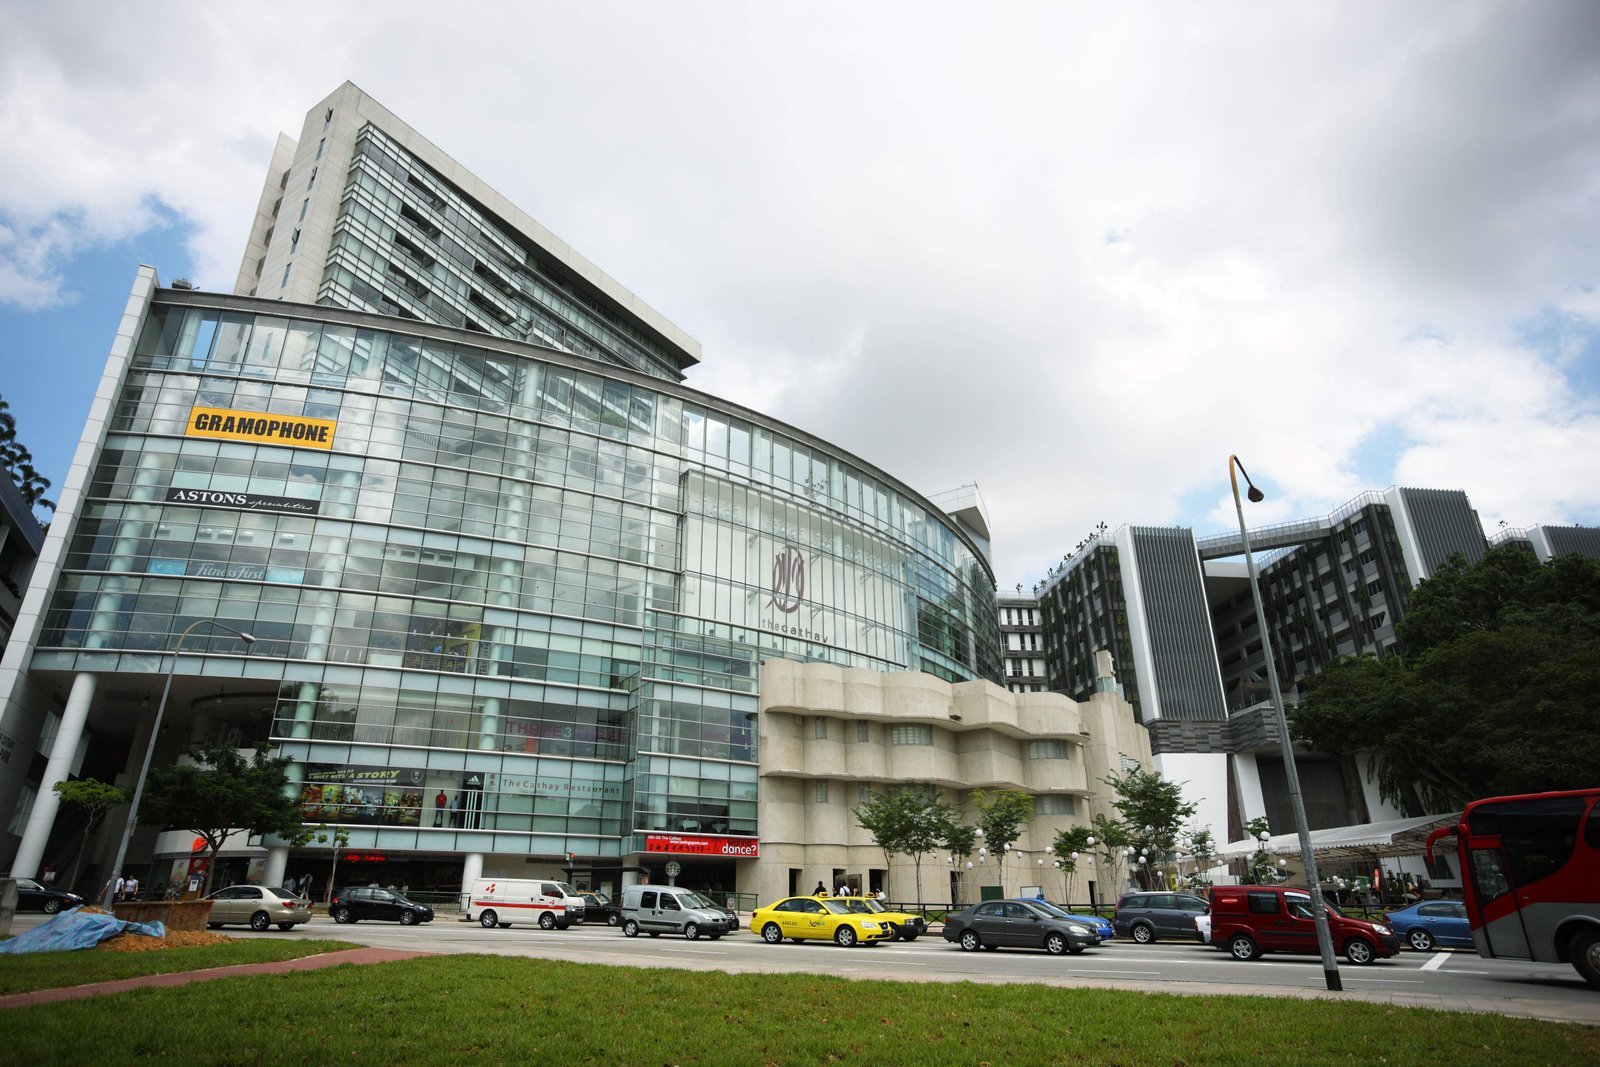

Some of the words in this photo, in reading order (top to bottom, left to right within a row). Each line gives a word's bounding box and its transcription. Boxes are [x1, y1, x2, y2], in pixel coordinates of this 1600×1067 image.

[194, 413, 329, 443] GRAMOPHONE
[173, 490, 247, 505] ASTONS
[356, 769, 400, 779] STORY
[503, 778, 521, 788] The
[523, 780, 560, 791] Cathay
[564, 784, 620, 795] Restaurant
[721, 843, 757, 854] dance?
